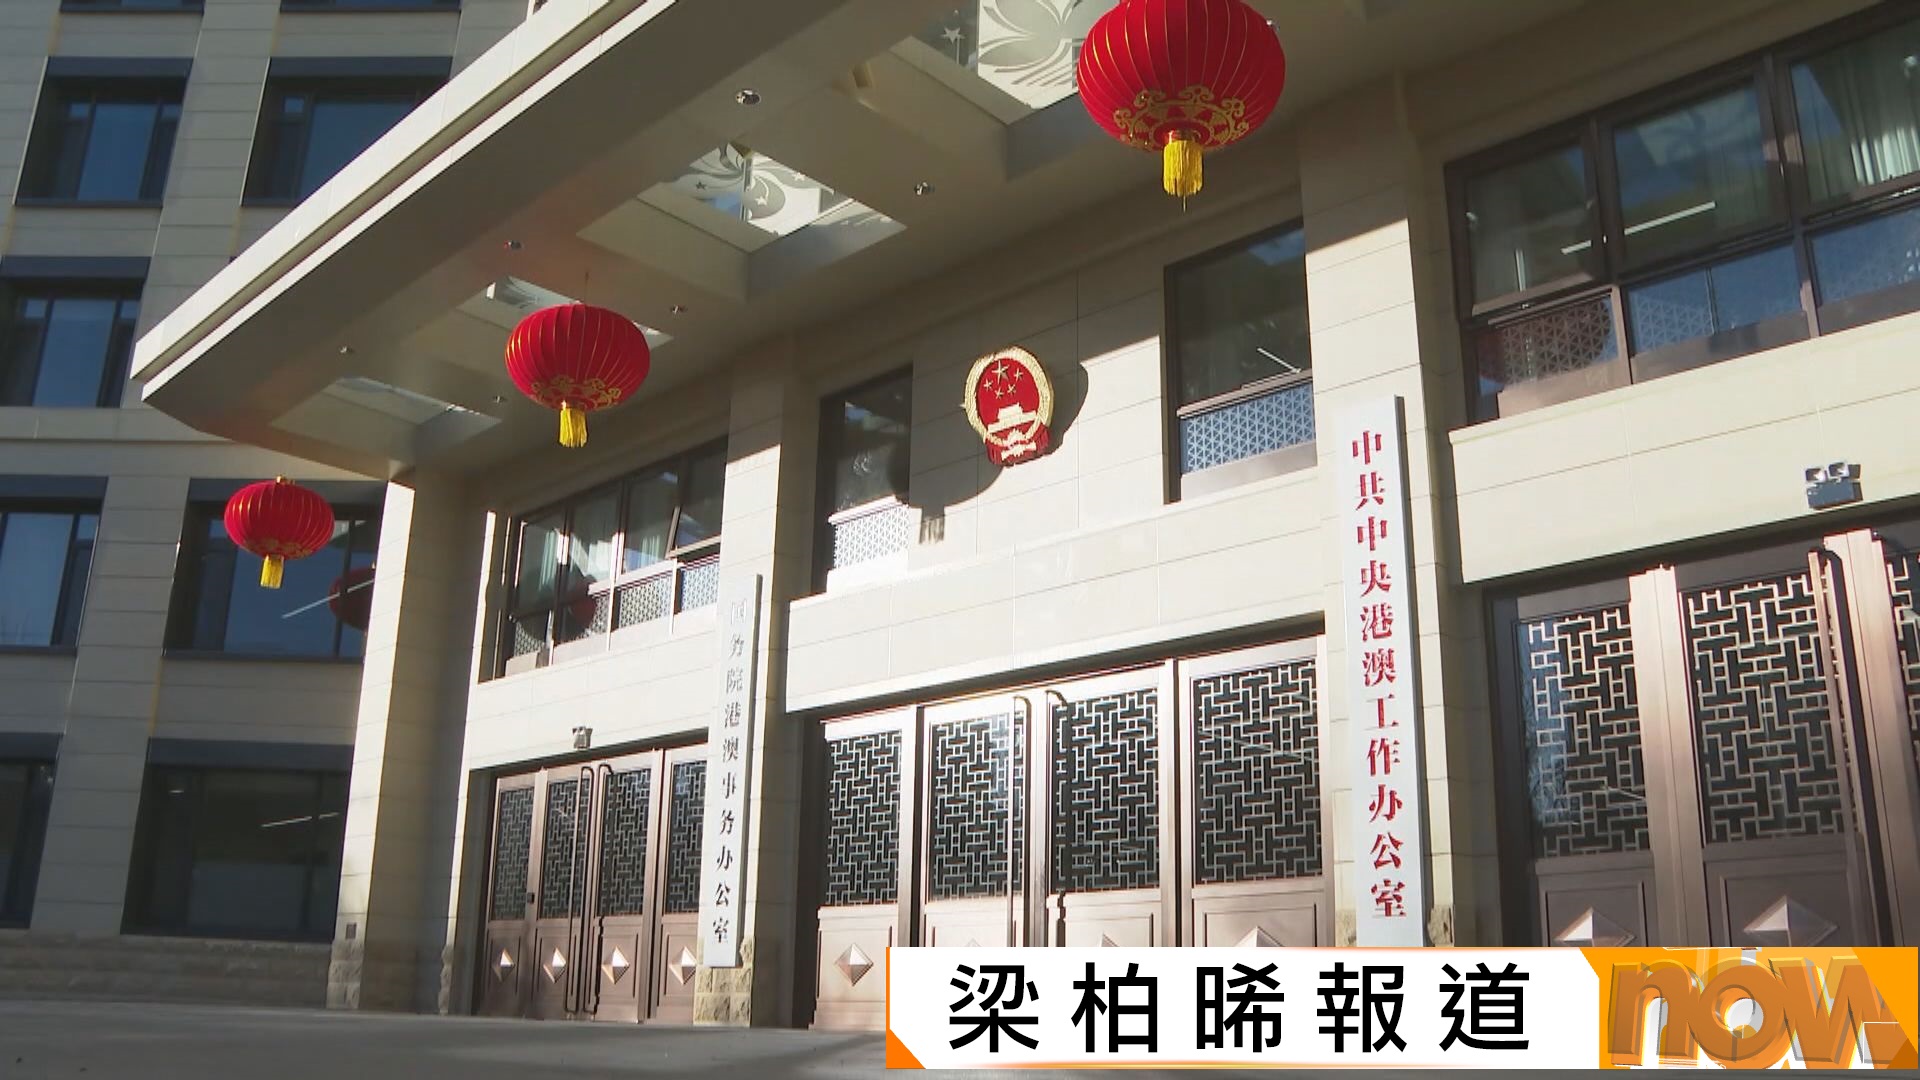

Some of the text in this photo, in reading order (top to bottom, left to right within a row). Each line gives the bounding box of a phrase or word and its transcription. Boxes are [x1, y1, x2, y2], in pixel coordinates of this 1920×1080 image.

[1351, 430, 1406, 918] 中共中央港澳工作办公室
